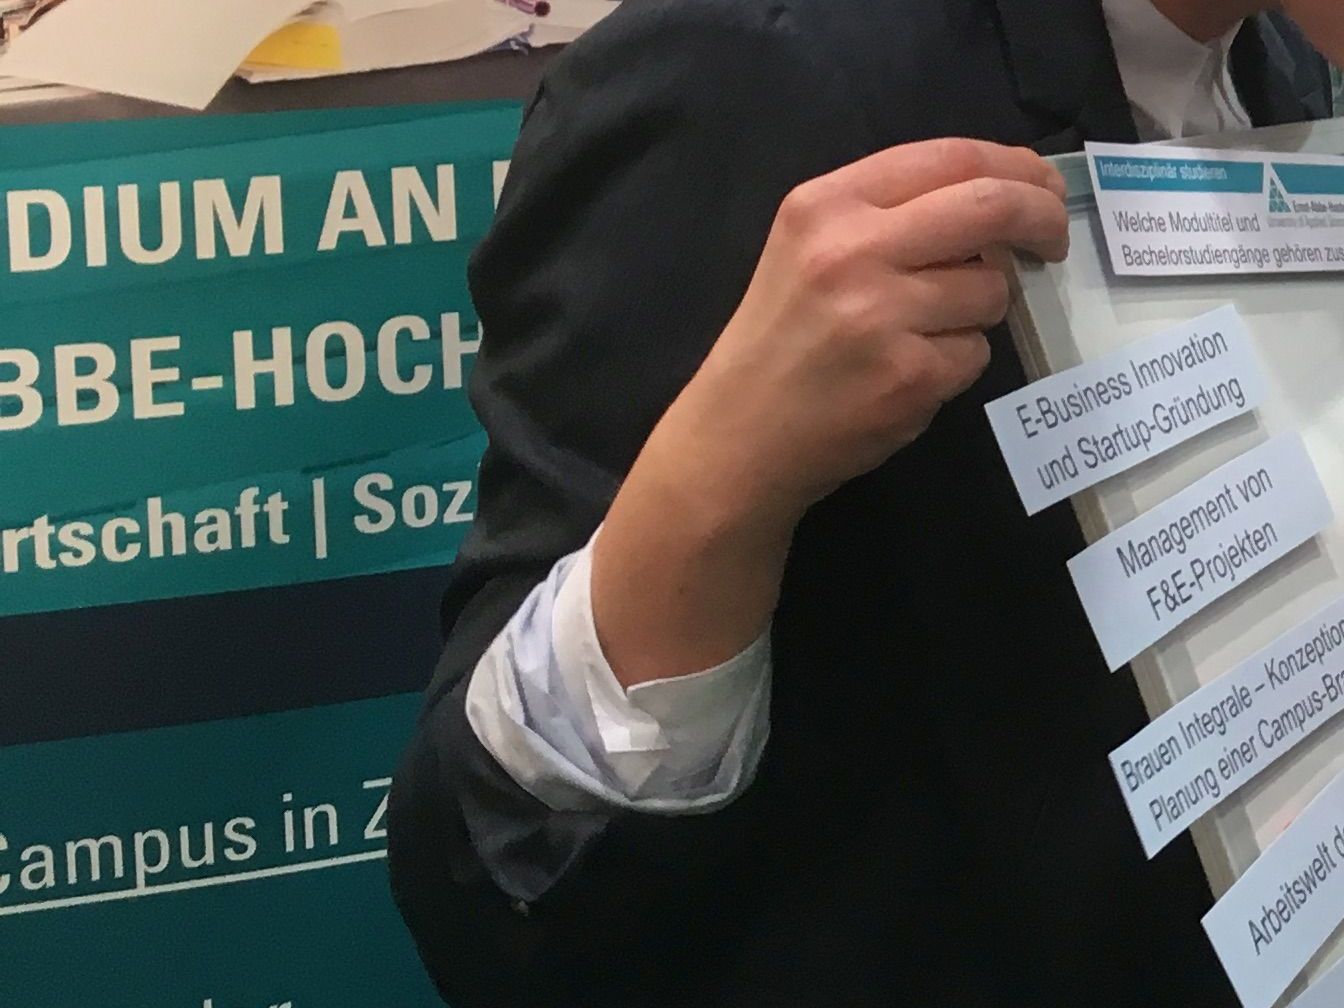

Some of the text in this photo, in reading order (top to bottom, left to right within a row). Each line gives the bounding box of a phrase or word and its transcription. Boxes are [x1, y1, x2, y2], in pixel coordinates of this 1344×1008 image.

[317, 163, 457, 252] AN
[1100, 160, 1227, 181] Interdisziplinär studieren
[1111, 210, 1168, 233] Welche
[1170, 212, 1234, 233] Modultitel
[1237, 213, 1261, 232] und
[1121, 243, 1270, 269] Bachelorstudiengänge
[1272, 244, 1323, 268] gehören
[1016, 330, 1229, 439] E-Business Innovation
[1036, 375, 1247, 490] und Startup-Gründung
[1116, 467, 1274, 579] Management von
[1146, 521, 1279, 622] F&E-Projekten
[1120, 733, 1183, 794] Brauen
[1178, 682, 1253, 750] Integrale
[1149, 766, 1220, 834] Planung
[1217, 735, 1259, 782] einer
[283, 792, 338, 853] in
[1248, 842, 1338, 958] Arbeitswelt
